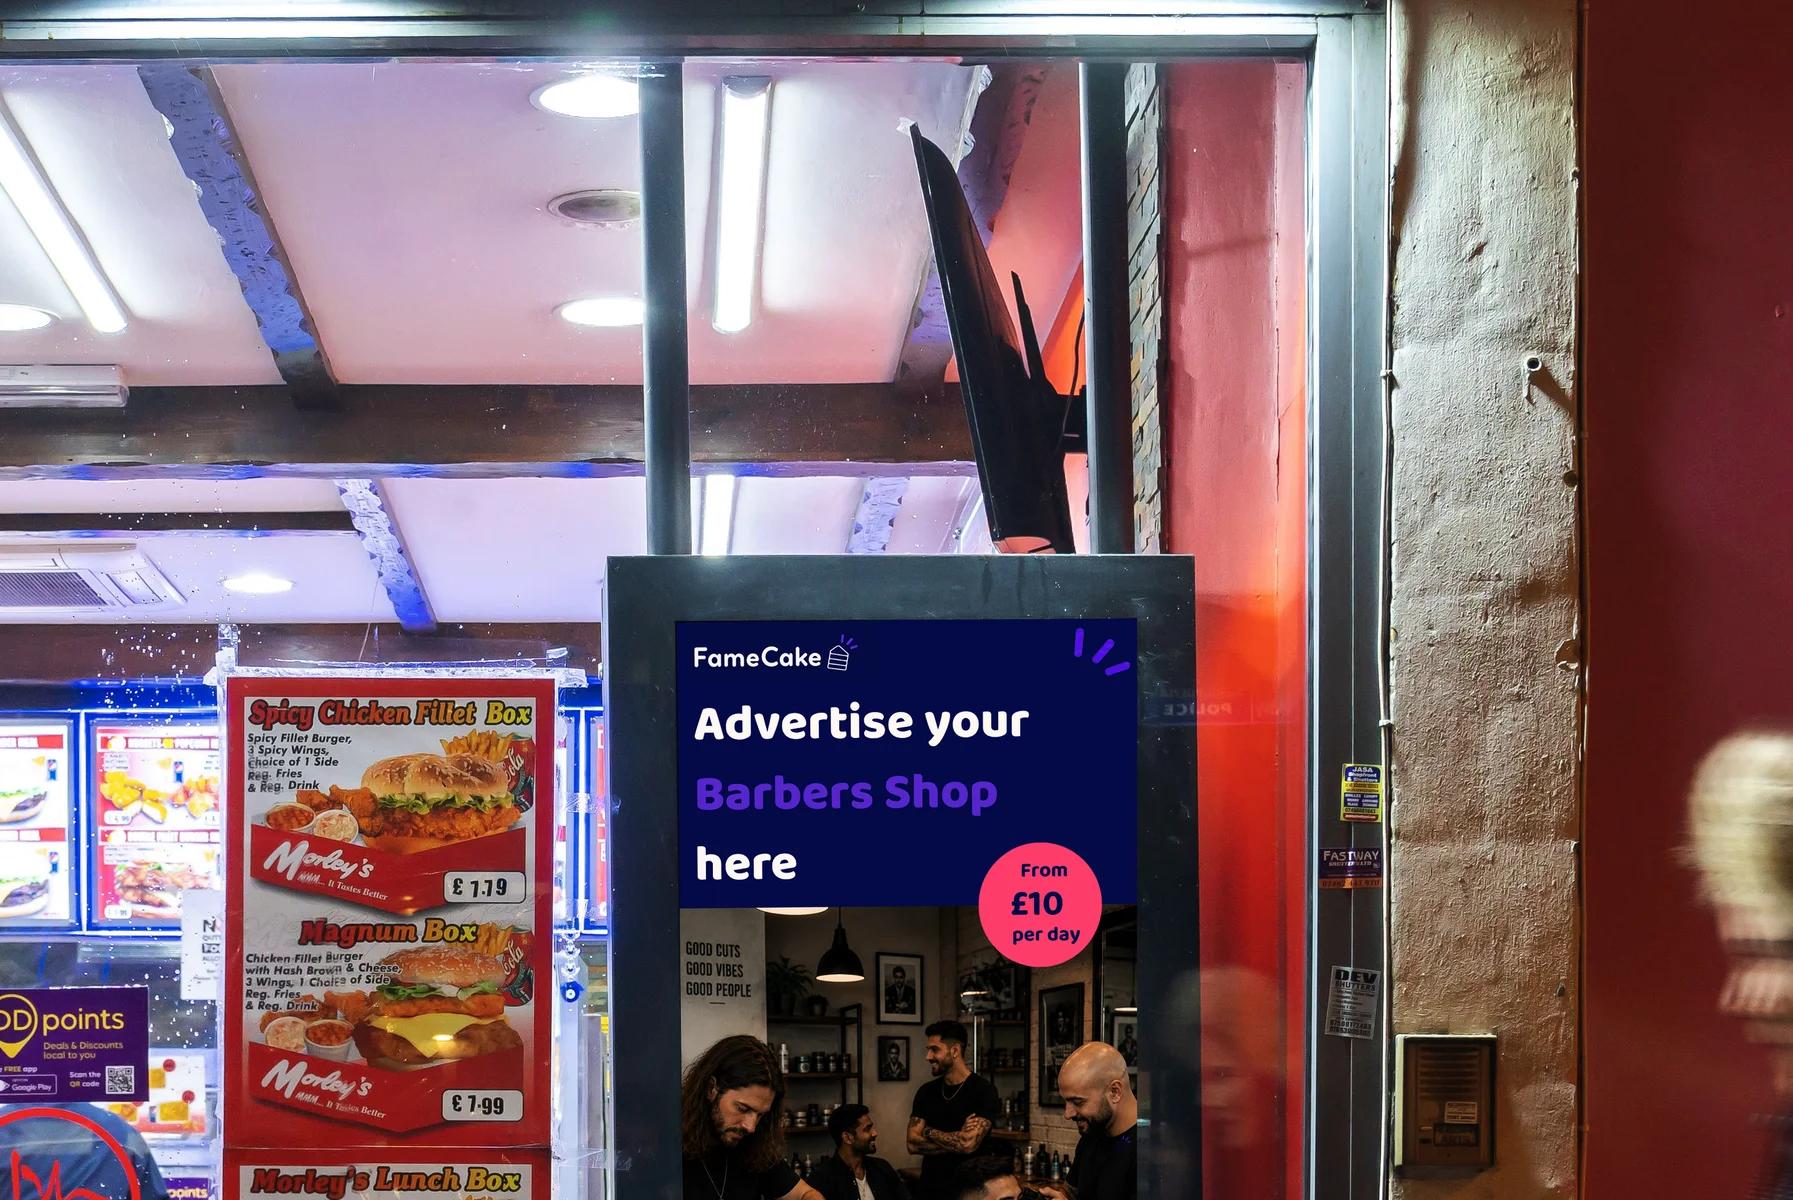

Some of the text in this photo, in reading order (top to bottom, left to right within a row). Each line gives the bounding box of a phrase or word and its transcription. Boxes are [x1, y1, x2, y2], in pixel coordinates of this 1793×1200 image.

[693, 646, 822, 668] FameCake
[248, 698, 533, 731] Spicy Chicken Fillet Box
[694, 701, 1030, 747] Advertise your
[247, 733, 352, 745] Spicy Fillet Burger,
[248, 745, 330, 756] 3 Spicy Wings,
[248, 757, 339, 768] Choice of 1 Side
[507, 747, 525, 782] ola
[276, 769, 303, 778] Fries
[248, 783, 256, 793] &
[288, 780, 320, 789] Drink
[696, 773, 998, 817] Barbers Shop
[263, 840, 374, 881] Morley's
[696, 845, 797, 880] here
[1323, 850, 1379, 861] FASTWAY
[1021, 863, 1068, 877] From
[337, 881, 361, 894] Tastes
[362, 888, 389, 901] Better
[452, 877, 464, 895] £
[1011, 891, 1063, 916] £10
[298, 917, 479, 949] Magnum Box
[1012, 926, 1081, 945] per day
[245, 952, 364, 963] Chicken Fillet Burger
[685, 941, 741, 958] GOOD CUTS
[245, 962, 402, 975] with Hash Brown & Cheese,
[686, 961, 744, 977] GOOD VIBES
[1334, 969, 1378, 984] DEV
[245, 978, 253, 987] 3
[256, 978, 294, 989] Wings,
[309, 976, 347, 987] Choice
[350, 974, 362, 984] of
[364, 974, 391, 984] Side
[686, 981, 752, 998] GOOD PEOPLE
[245, 989, 301, 1001] Reg. Fries
[245, 1001, 318, 1012] & Reg. Drink
[42, 1008, 125, 1036] points
[43, 1041, 124, 1050] Deals & Discounts
[43, 1051, 66, 1060] local
[79, 1052, 97, 1061] you
[11, 1083, 52, 1092] Google Play
[261, 1059, 373, 1101] Morley's
[452, 1094, 463, 1112] £
[360, 1106, 387, 1119] Better
[250, 1165, 522, 1200] Morley's Lunch Box
